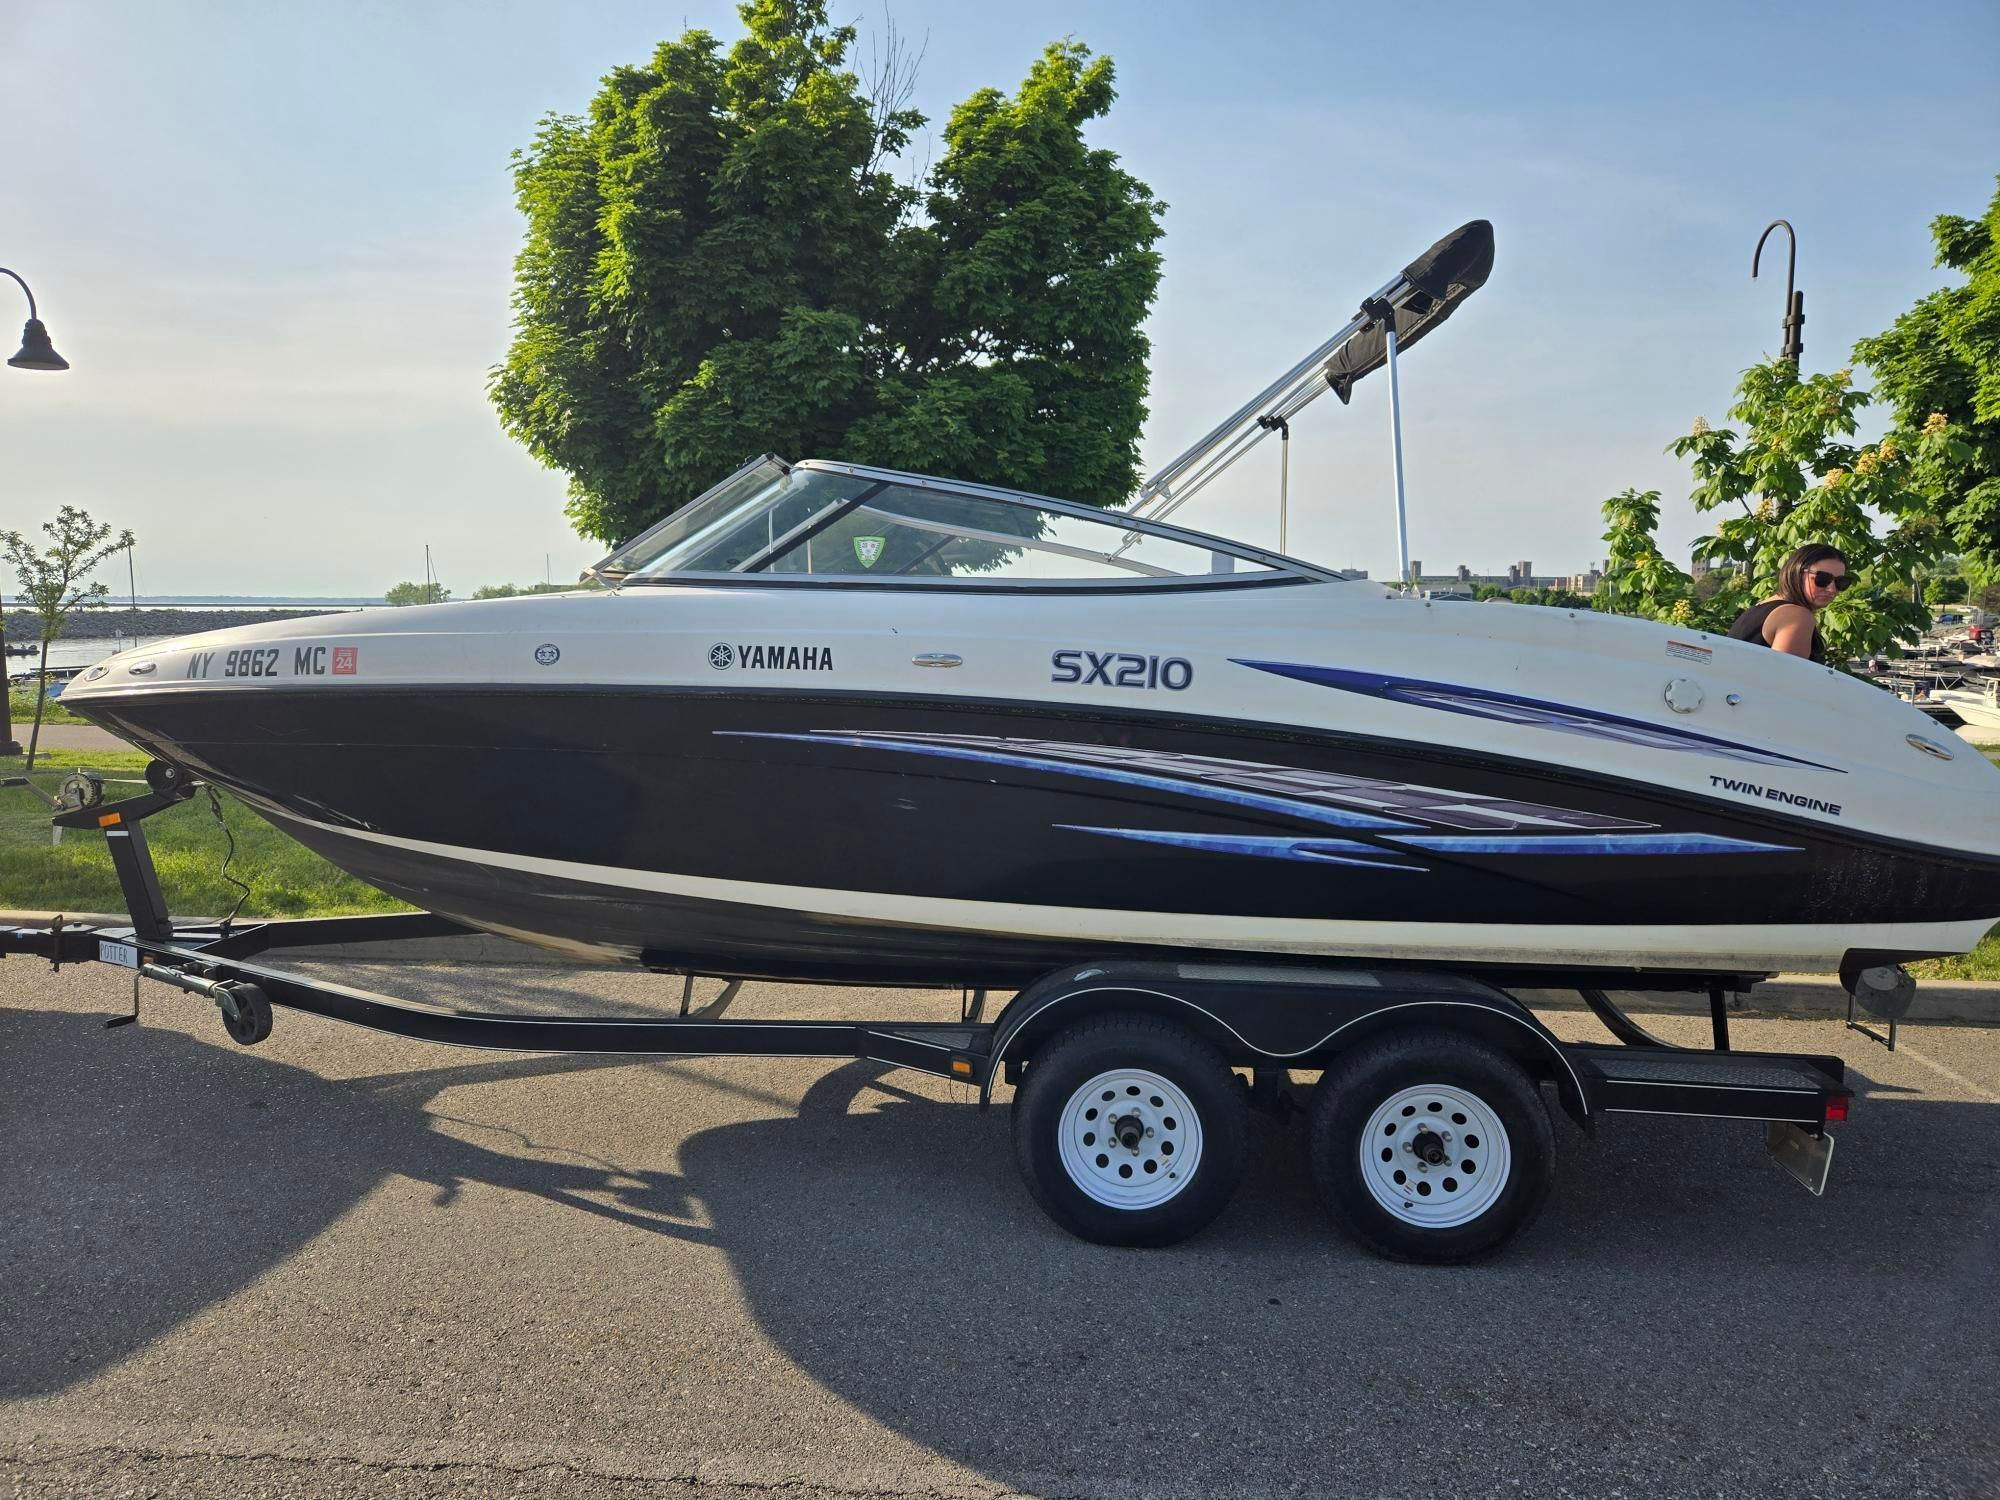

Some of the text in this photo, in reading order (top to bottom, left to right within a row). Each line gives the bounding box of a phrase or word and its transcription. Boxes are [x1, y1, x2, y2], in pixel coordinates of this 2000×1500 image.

[187, 647, 326, 678] NY 9862 MC
[336, 656, 353, 669] 24
[738, 645, 833, 671] YAMAHA
[1051, 649, 1194, 691] SX210
[1710, 775, 1842, 816] TWIN ENGINE
[101, 943, 128, 964] POTTER
